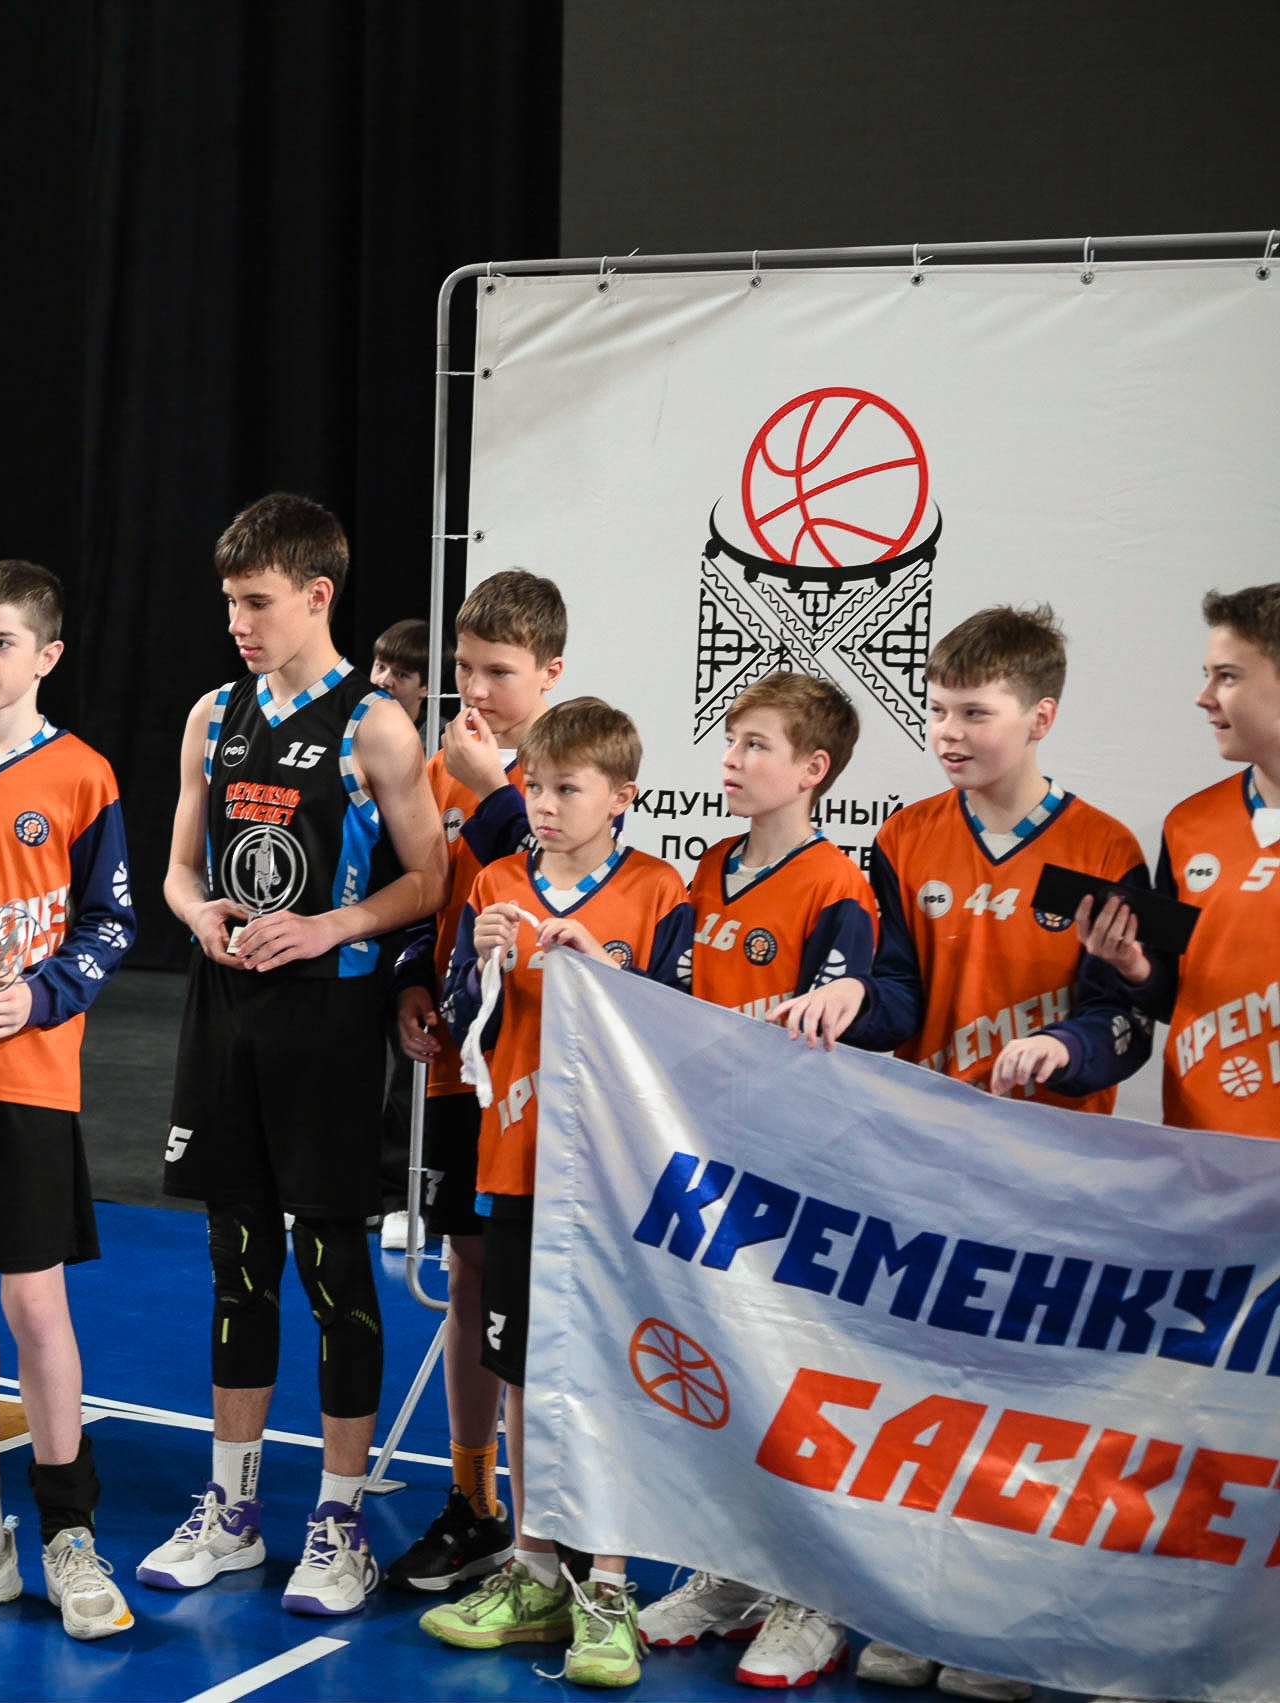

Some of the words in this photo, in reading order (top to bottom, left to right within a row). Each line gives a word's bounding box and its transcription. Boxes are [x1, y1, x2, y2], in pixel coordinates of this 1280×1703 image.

[278, 741, 328, 770] 15
[1240, 857, 1280, 891] 5
[964, 883, 1021, 920] 44
[694, 913, 742, 951] 16
[756, 1367, 1280, 1568] БАСКЕ
